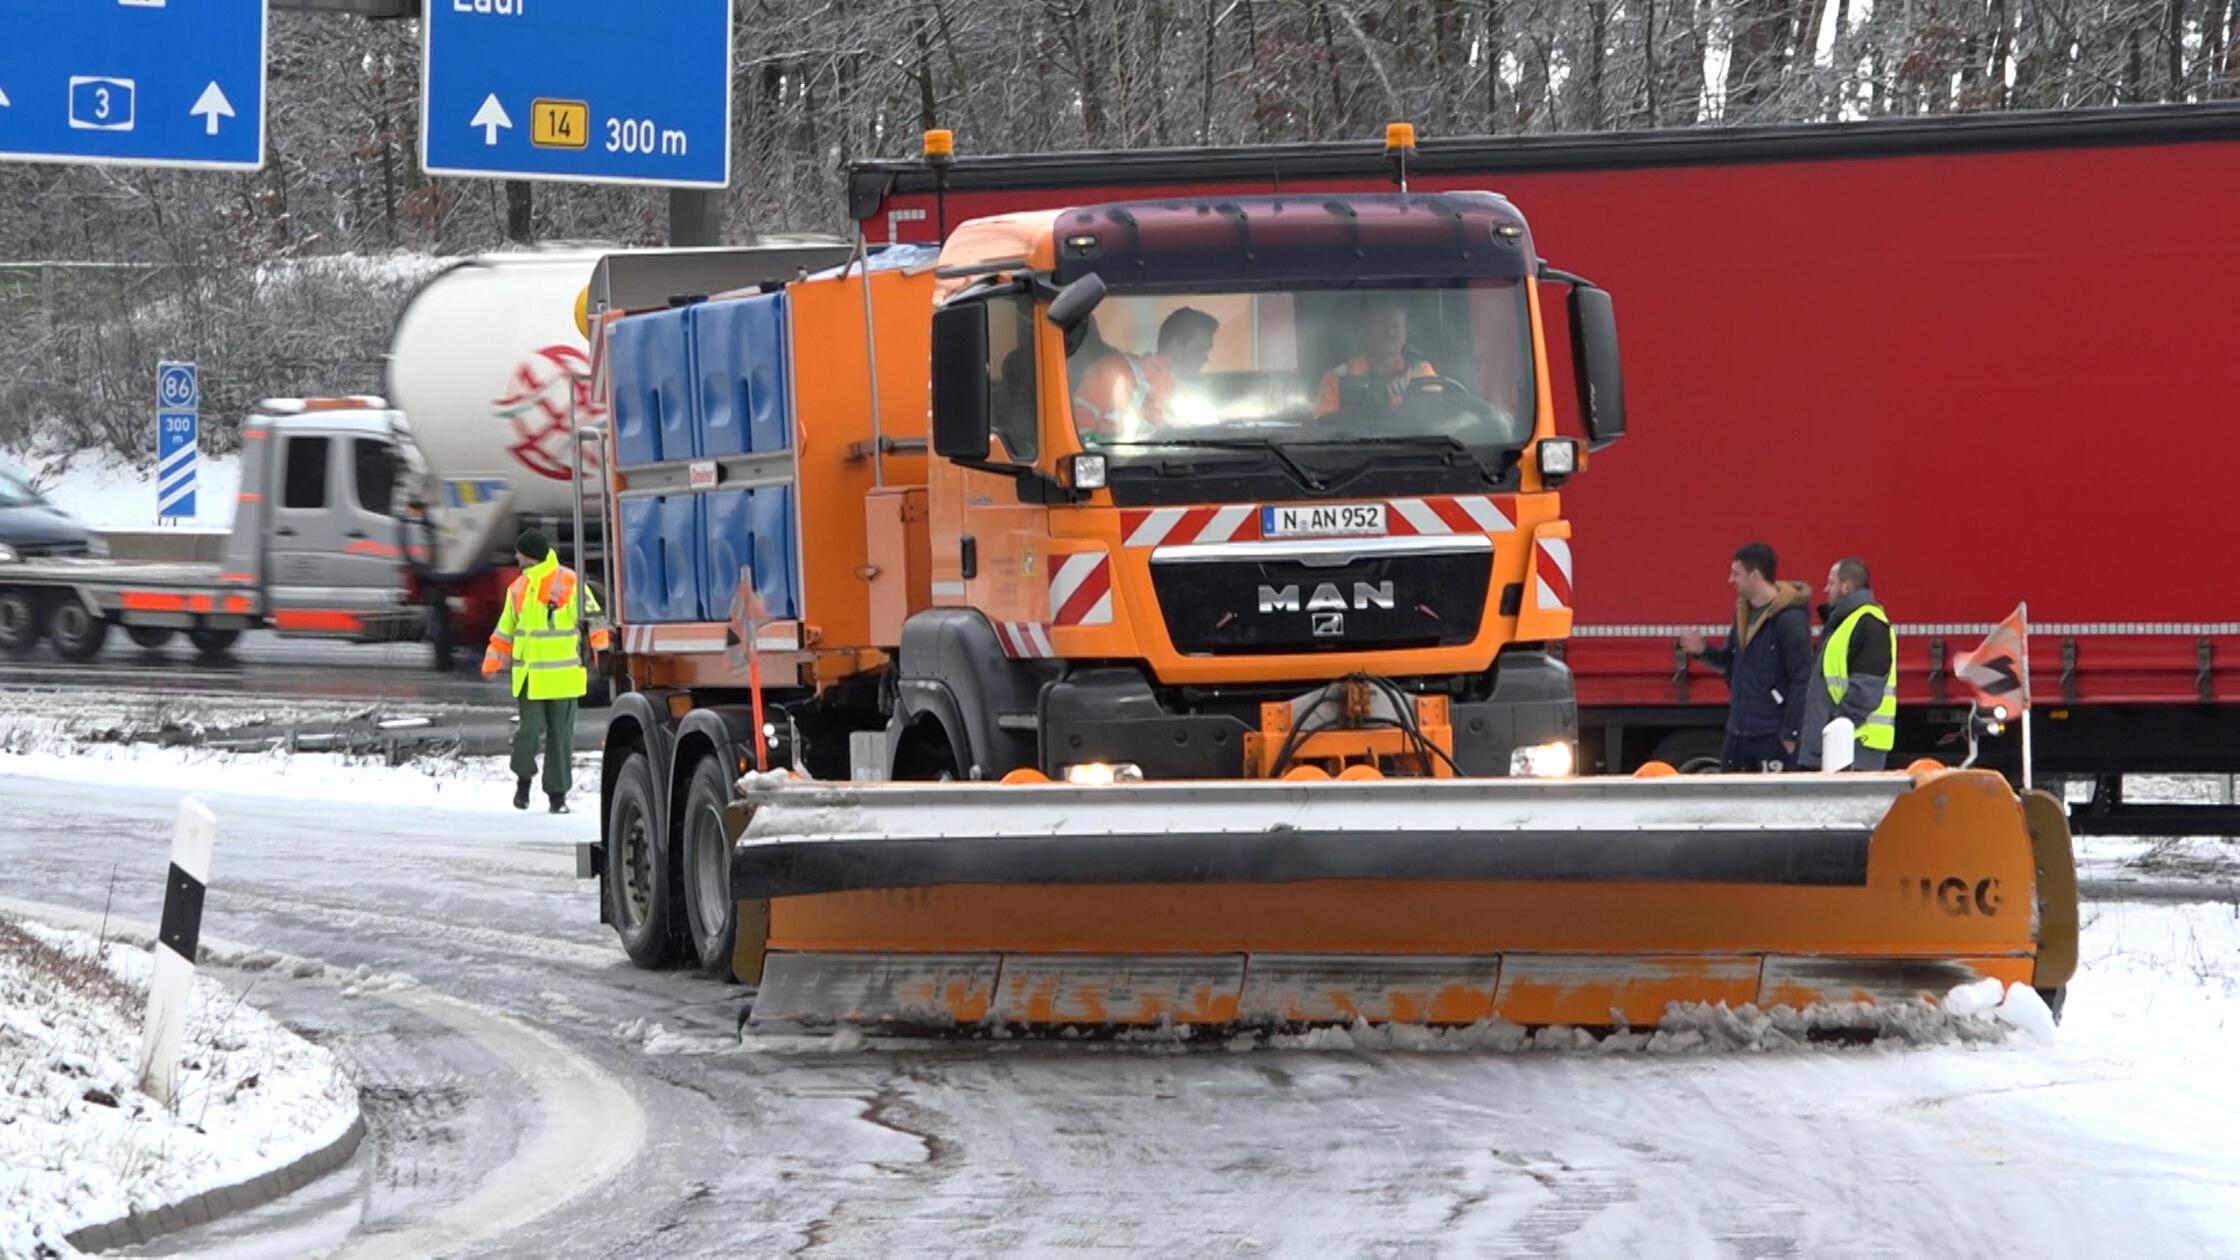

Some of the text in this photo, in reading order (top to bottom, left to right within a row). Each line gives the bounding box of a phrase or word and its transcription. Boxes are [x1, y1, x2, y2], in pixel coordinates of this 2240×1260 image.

[95, 87, 109, 119] 3
[548, 109, 571, 138] 14
[605, 117, 687, 156] 300 m
[165, 376, 190, 398] 86
[166, 417, 190, 432] 300
[172, 434, 183, 444] m
[1311, 508, 1337, 529] AN
[1341, 507, 1379, 527] 952
[1258, 580, 1395, 613] MAN
